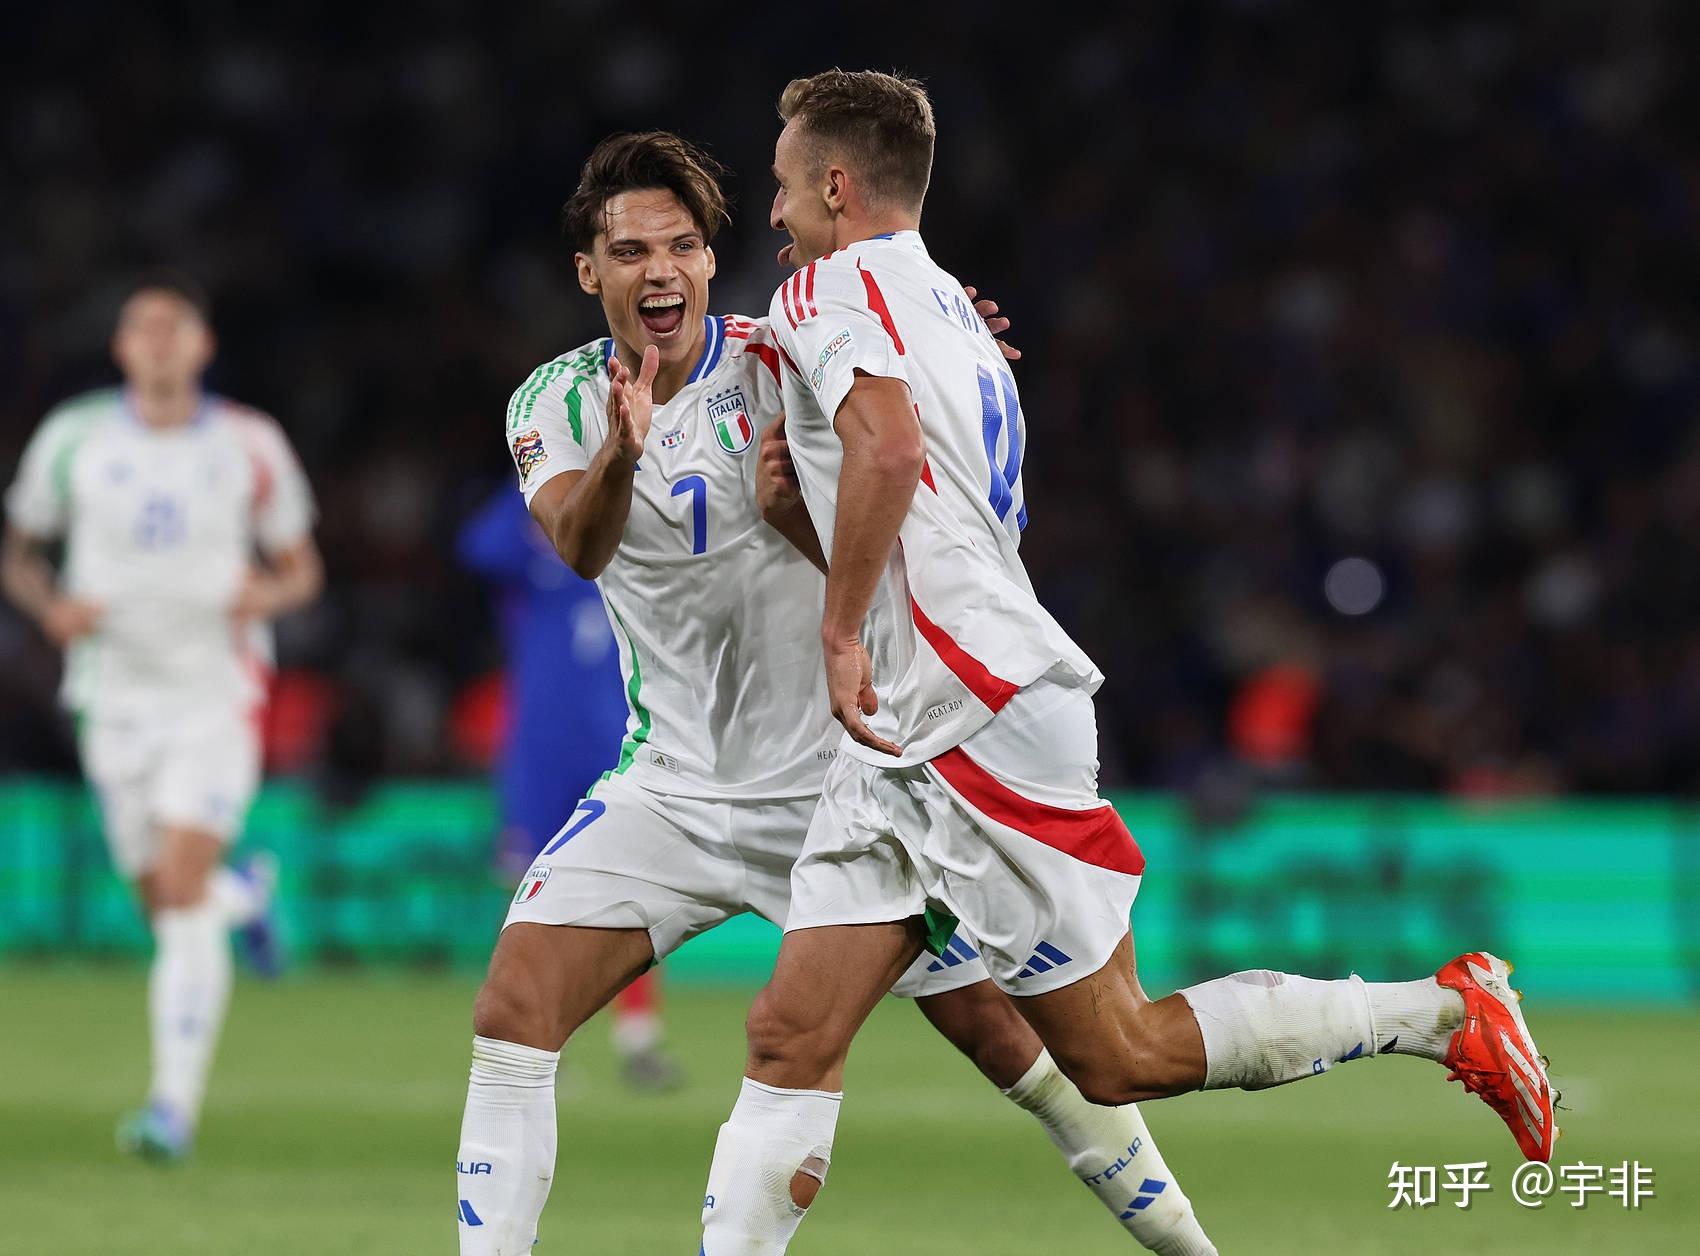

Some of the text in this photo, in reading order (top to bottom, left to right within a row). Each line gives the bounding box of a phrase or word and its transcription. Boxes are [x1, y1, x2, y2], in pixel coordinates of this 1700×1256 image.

[711, 397, 743, 419] ITALIA
[671, 475, 707, 555] 7
[543, 799, 606, 856] 7
[1083, 1136, 1142, 1187] ITALIA
